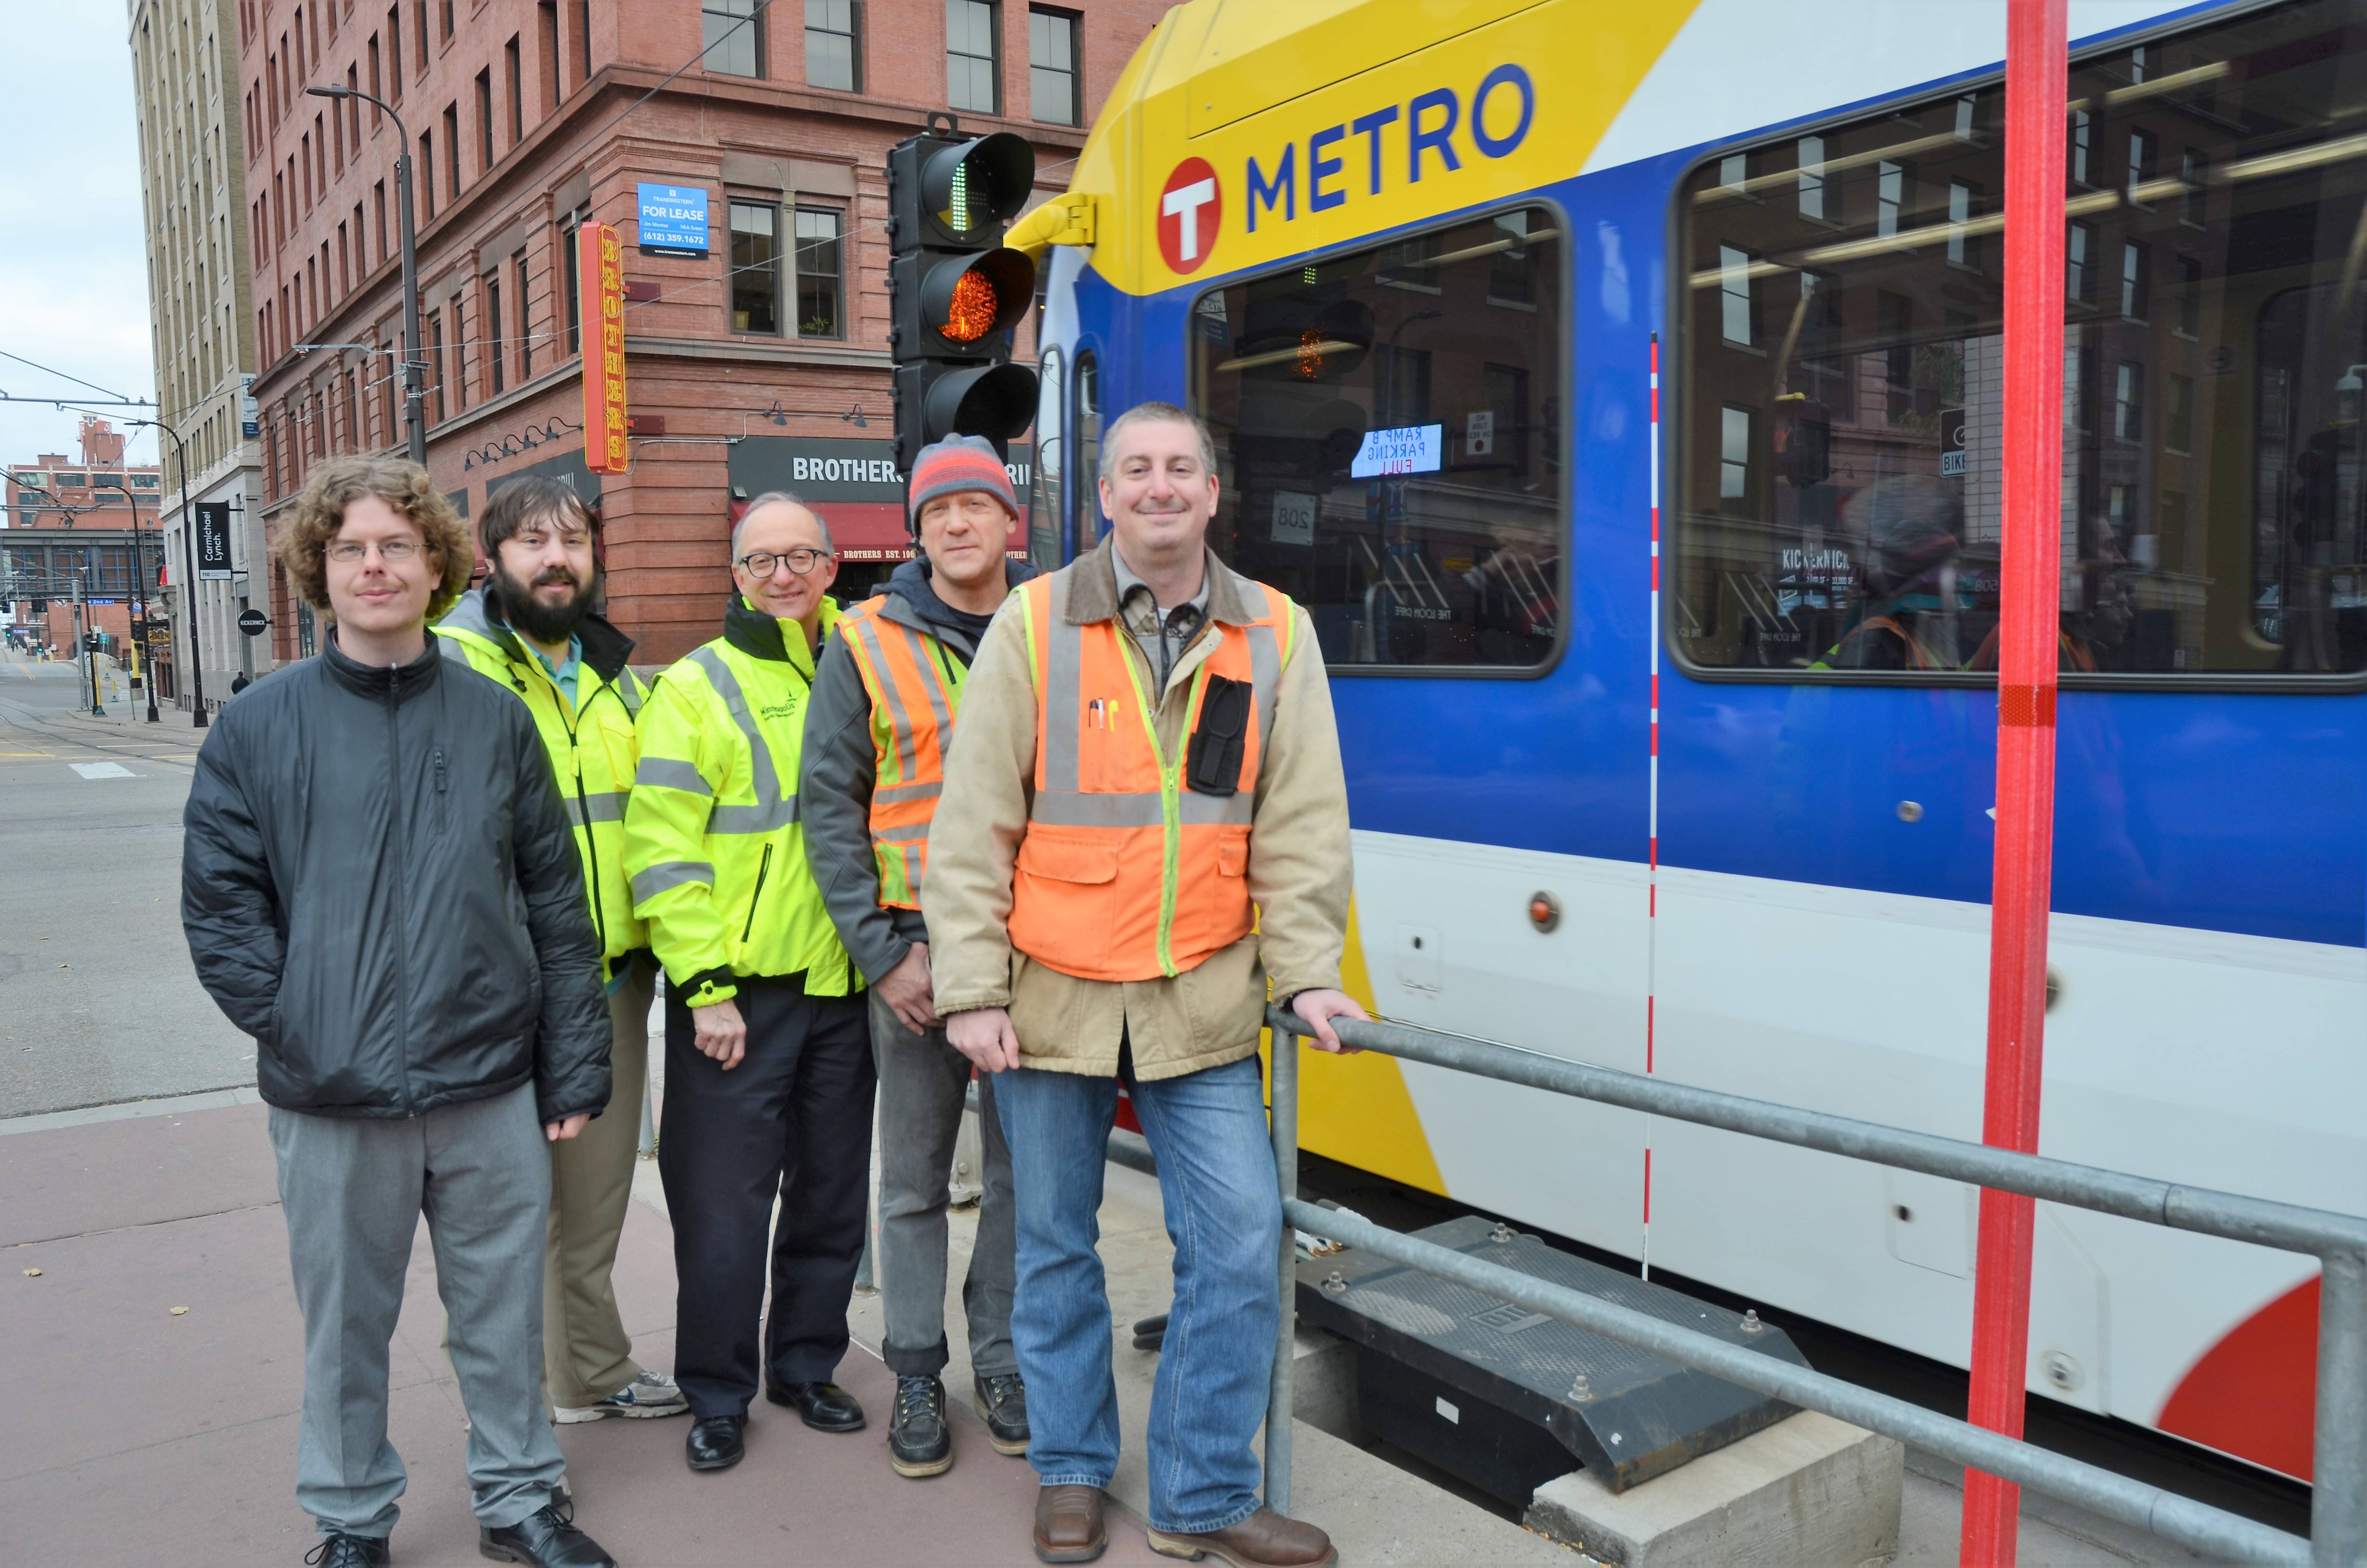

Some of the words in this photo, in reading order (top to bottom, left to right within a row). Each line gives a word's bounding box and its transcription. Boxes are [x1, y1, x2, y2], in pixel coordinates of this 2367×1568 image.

[1246, 63, 1535, 234] METRO
[653, 196, 693, 204] TRANSWESTERN
[642, 205, 667, 218] FOR
[669, 208, 704, 221] LEASE
[1163, 177, 1215, 261] T
[644, 232, 664, 241] (612)
[667, 234, 704, 244] 359.1672
[603, 238, 623, 459] BROTHERS
[202, 511, 213, 561] Carmichael
[213, 532, 224, 561] Lynch.
[844, 550, 882, 559] BROTHERS
[885, 550, 901, 559] EST.
[760, 703, 795, 716] Minneapolis
